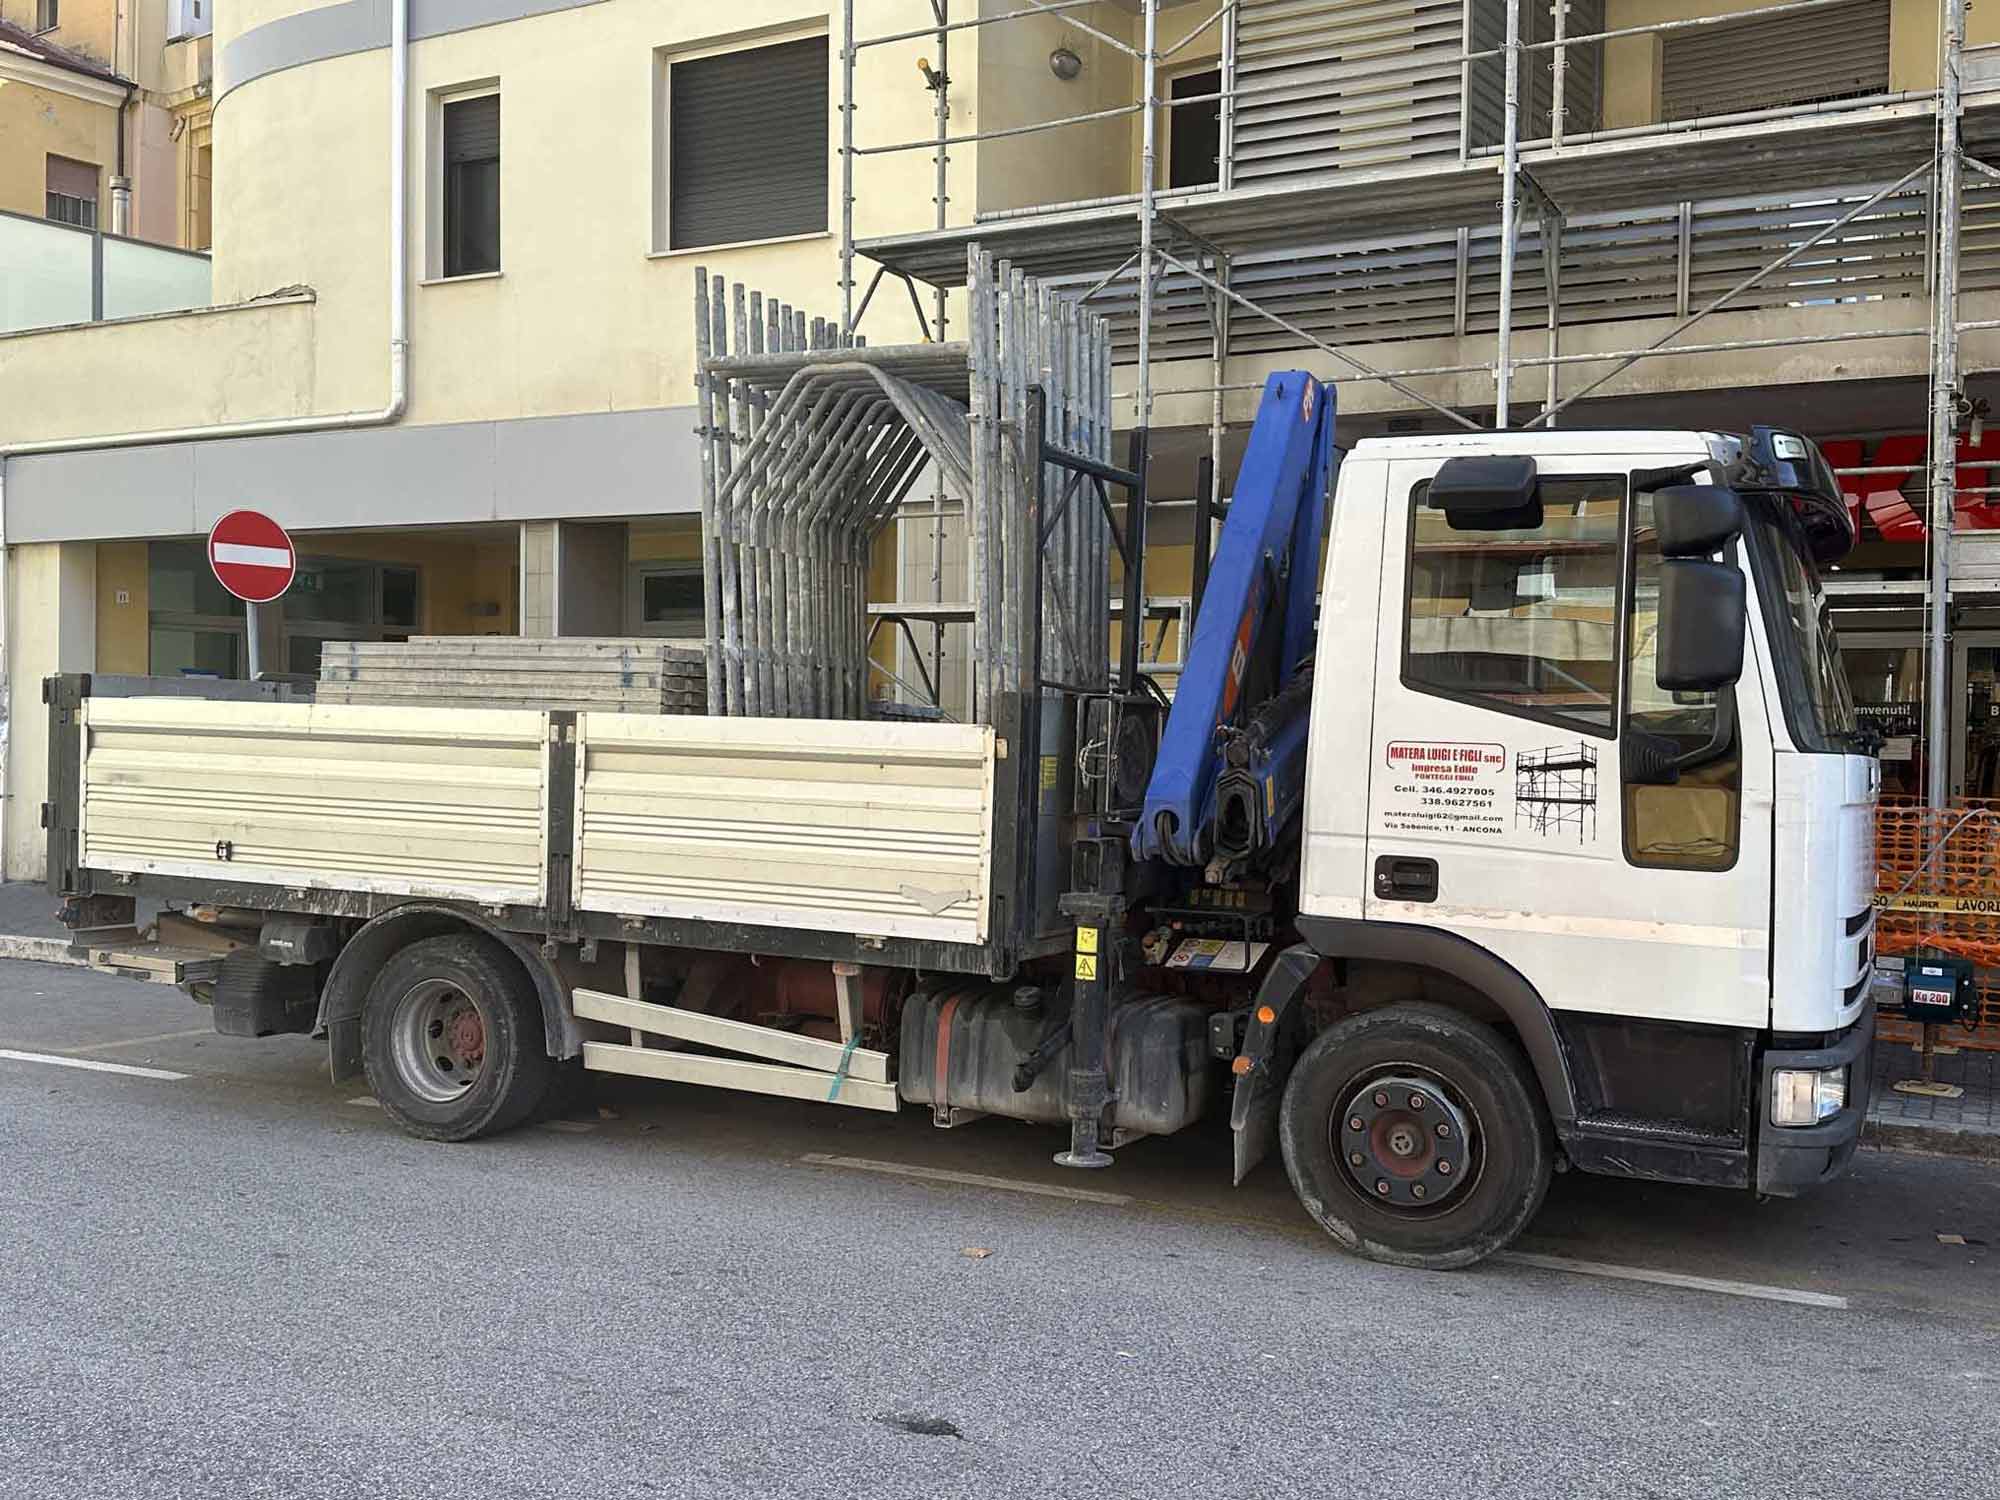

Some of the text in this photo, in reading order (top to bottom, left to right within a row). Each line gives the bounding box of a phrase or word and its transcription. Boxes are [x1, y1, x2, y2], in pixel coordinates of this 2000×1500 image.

[1853, 704, 1911, 715] envenuti!
[1390, 747, 1502, 764] MATERA LUIGI E FIGLI snc
[1411, 763, 1478, 774] Impresa Edile
[1394, 785, 1418, 793] Cell.
[1421, 798, 1493, 808] 338.9627561
[1462, 826, 1503, 834] ANCONA
[1903, 901, 1939, 909] MAURER
[1929, 993, 1948, 1004] 200
